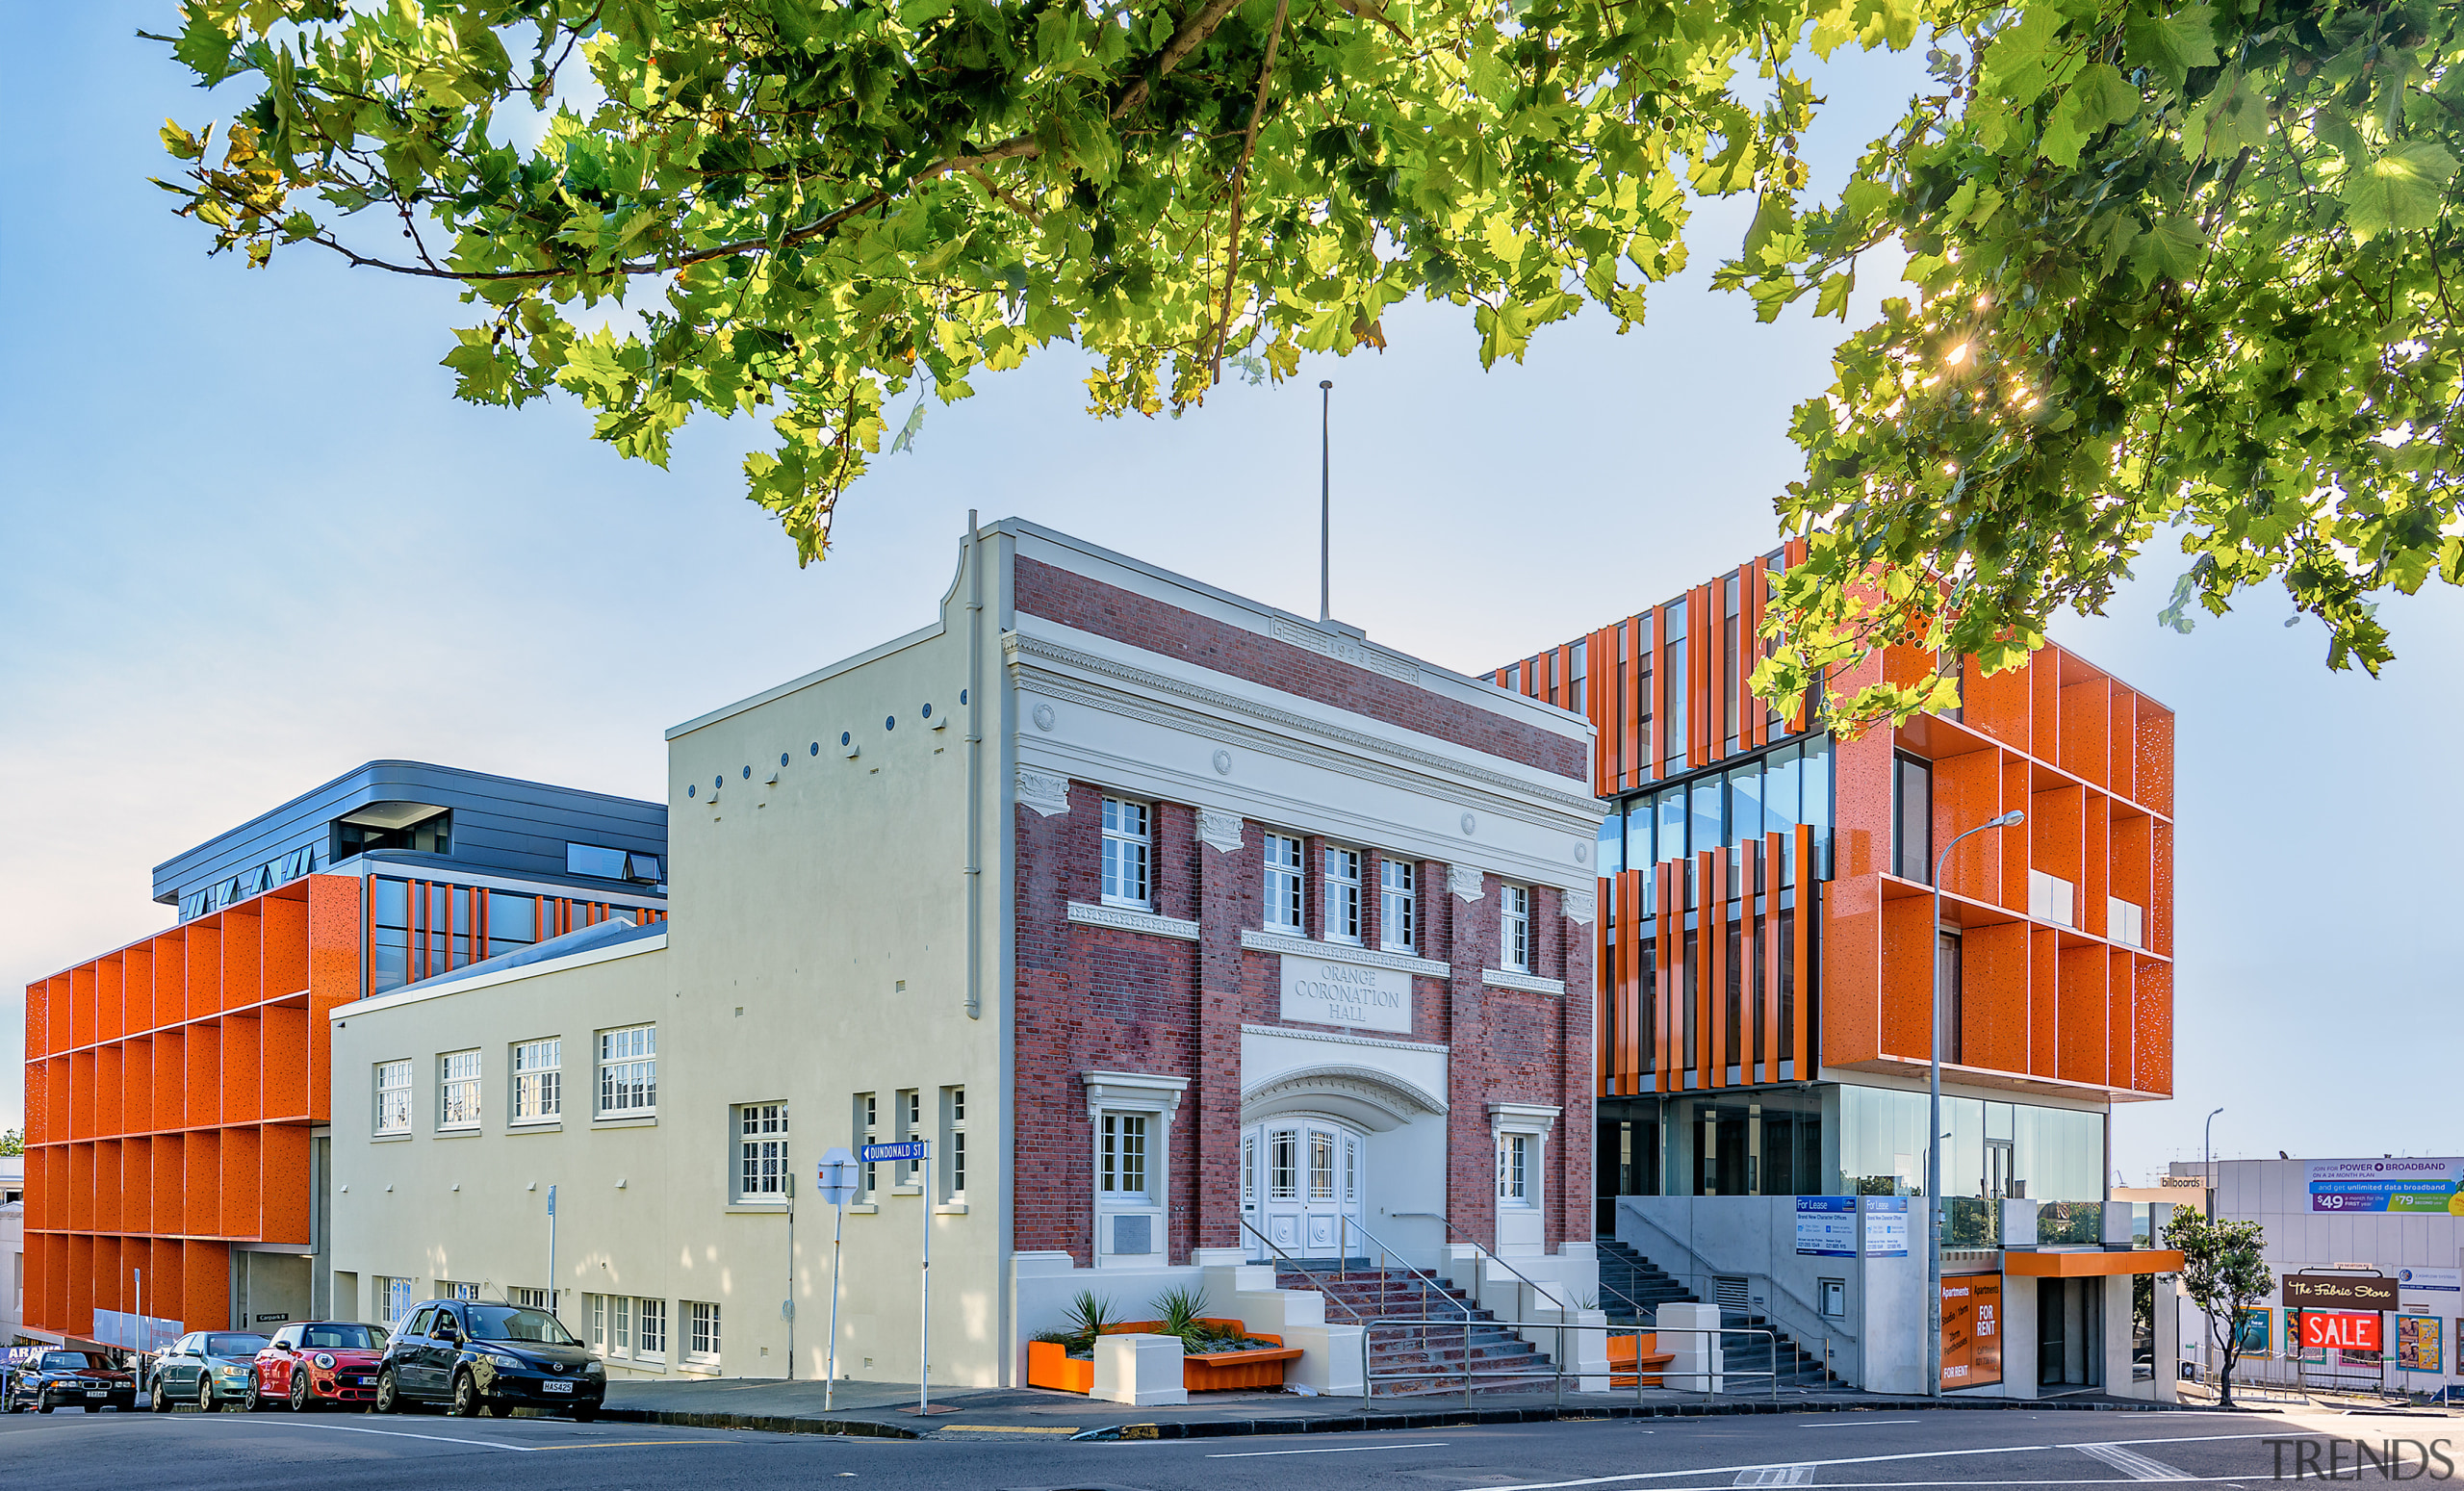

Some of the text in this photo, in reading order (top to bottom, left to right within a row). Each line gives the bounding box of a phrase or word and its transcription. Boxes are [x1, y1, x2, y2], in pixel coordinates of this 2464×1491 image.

[1329, 642, 1366, 663] 1923
[1322, 965, 1376, 987] ORANGE
[1295, 980, 1399, 1008] CORONATION
[1329, 1003, 1367, 1022] HALL
[870, 1144, 922, 1159] DUNDONALD ST
[2162, 1177, 2200, 1188] billboards
[1798, 1199, 1828, 1210] For Lease
[2318, 1195, 2344, 1209] $49
[2395, 1195, 2414, 1205] $79
[1942, 1287, 1969, 1299] Apartments
[1974, 1285, 1999, 1298] Apartments
[2288, 1280, 2312, 1296] The
[2314, 1284, 2352, 1297] Fabric
[2354, 1286, 2391, 1298] Store
[1941, 1305, 1969, 1326] Studio 1brm
[1979, 1305, 1993, 1321] FOR
[1949, 1330, 1961, 1342] 2brm
[1977, 1321, 1995, 1337] RENT
[2309, 1317, 2372, 1346] SALE
[1944, 1337, 1967, 1356] Penthouses
[1944, 1365, 1968, 1378] FOR RENT
[545, 1382, 572, 1392] HAS425
